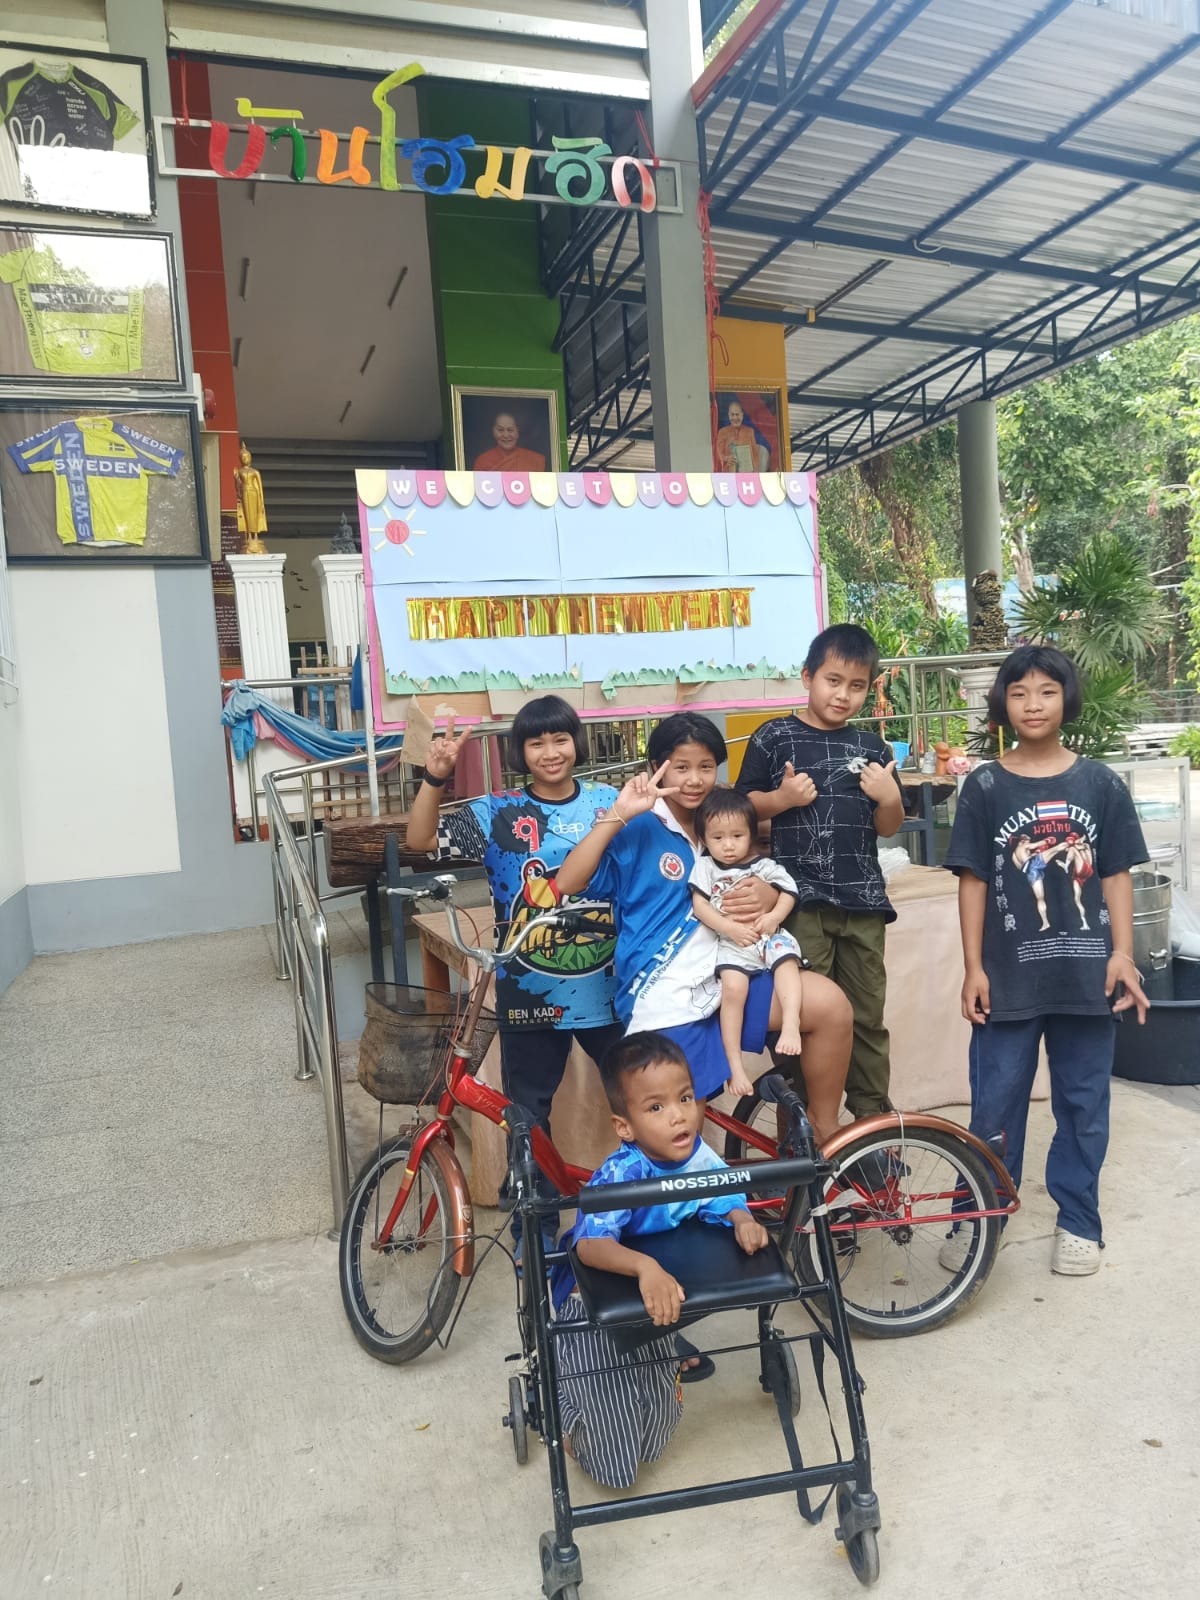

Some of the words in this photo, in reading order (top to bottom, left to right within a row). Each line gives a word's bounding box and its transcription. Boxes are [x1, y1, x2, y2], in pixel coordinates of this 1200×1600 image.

[120, 424, 177, 455] SWEDEN
[55, 457, 142, 474] SWEDEN
[392, 480, 578, 496] WECOE
[642, 480, 730, 497] HOE
[742, 480, 803, 496] HG
[993, 804, 1039, 849] MUAY
[1033, 819, 1072, 836] มวยไทย
[508, 1008, 529, 1020] BEN
[533, 1006, 563, 1019] KADO
